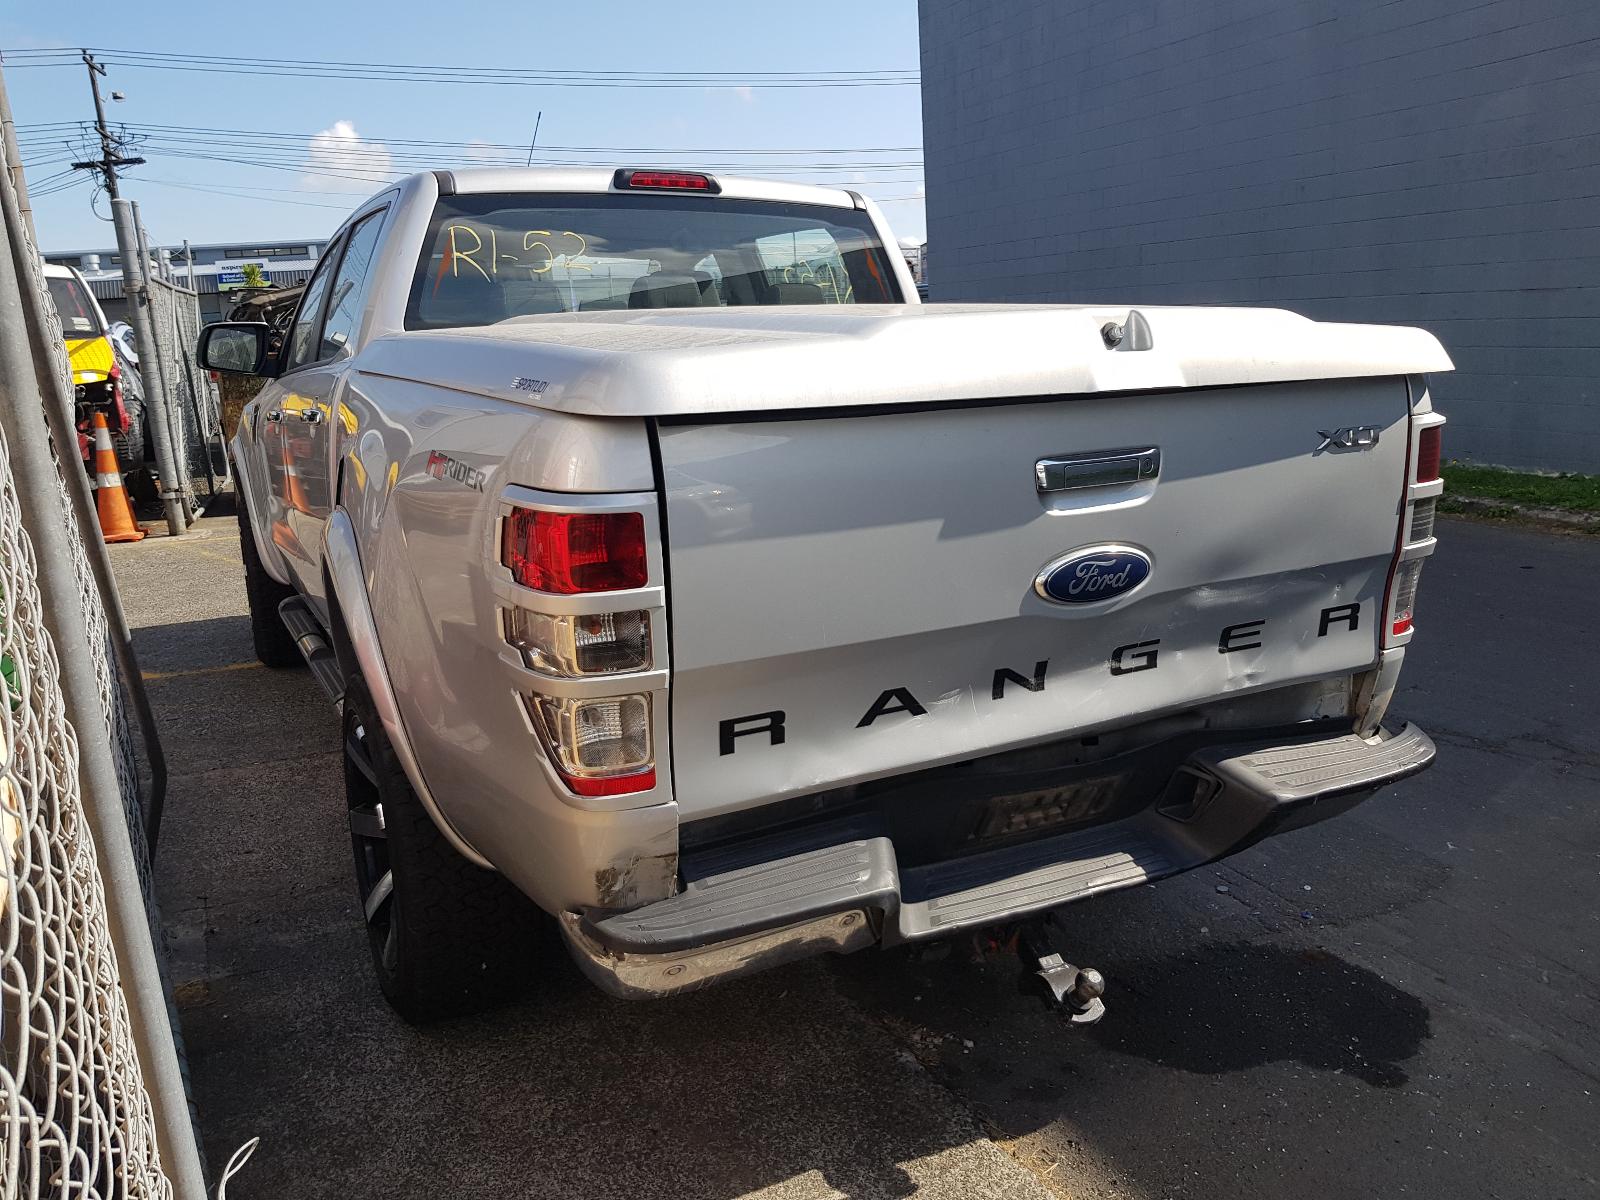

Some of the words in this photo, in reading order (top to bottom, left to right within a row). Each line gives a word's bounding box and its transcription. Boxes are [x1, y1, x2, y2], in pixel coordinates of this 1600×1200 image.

[1312, 425, 1382, 457] XLT
[1069, 559, 1132, 595] Ford
[719, 602, 1360, 757] RANGER
